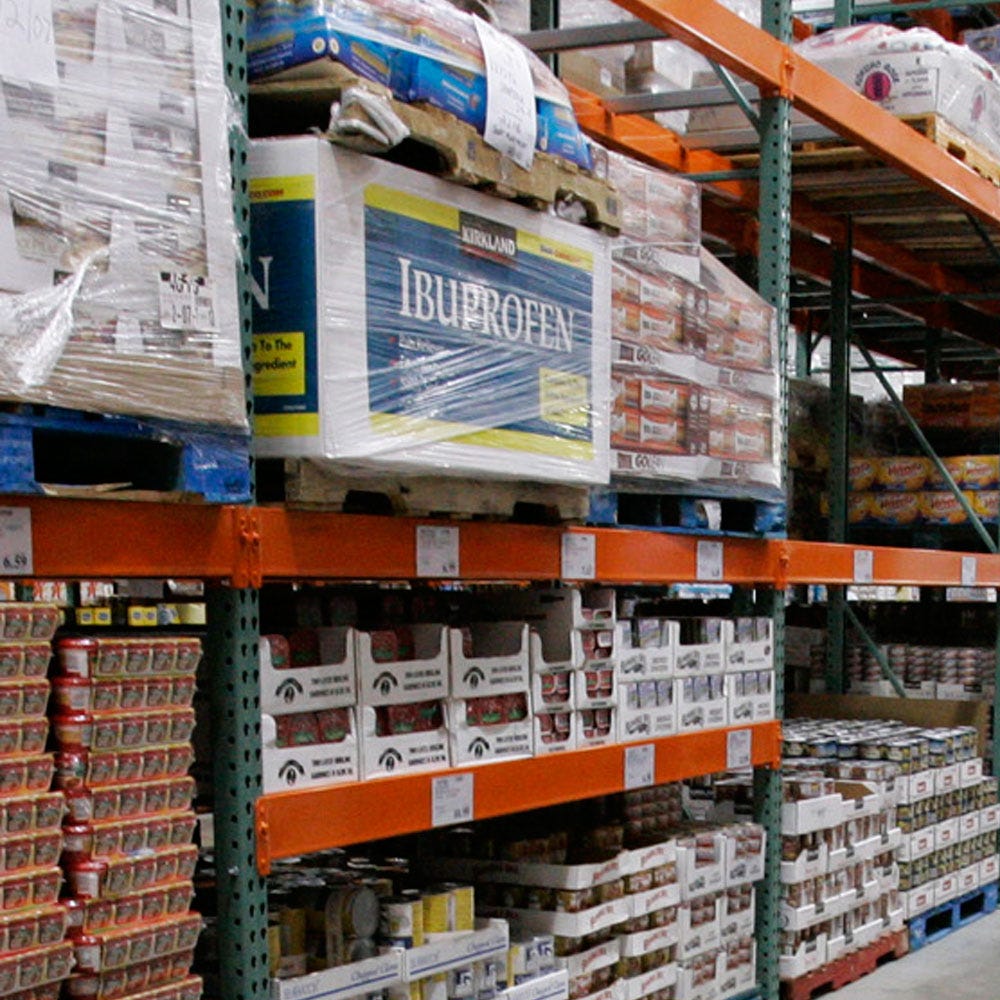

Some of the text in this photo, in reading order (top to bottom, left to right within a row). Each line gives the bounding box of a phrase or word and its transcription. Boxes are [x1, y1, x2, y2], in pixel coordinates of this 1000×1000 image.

[461, 225, 516, 256] KIRKLAND
[398, 257, 576, 352] IBUPROFEN
[275, 338, 292, 350] The
[253, 360, 297, 374] gredient
